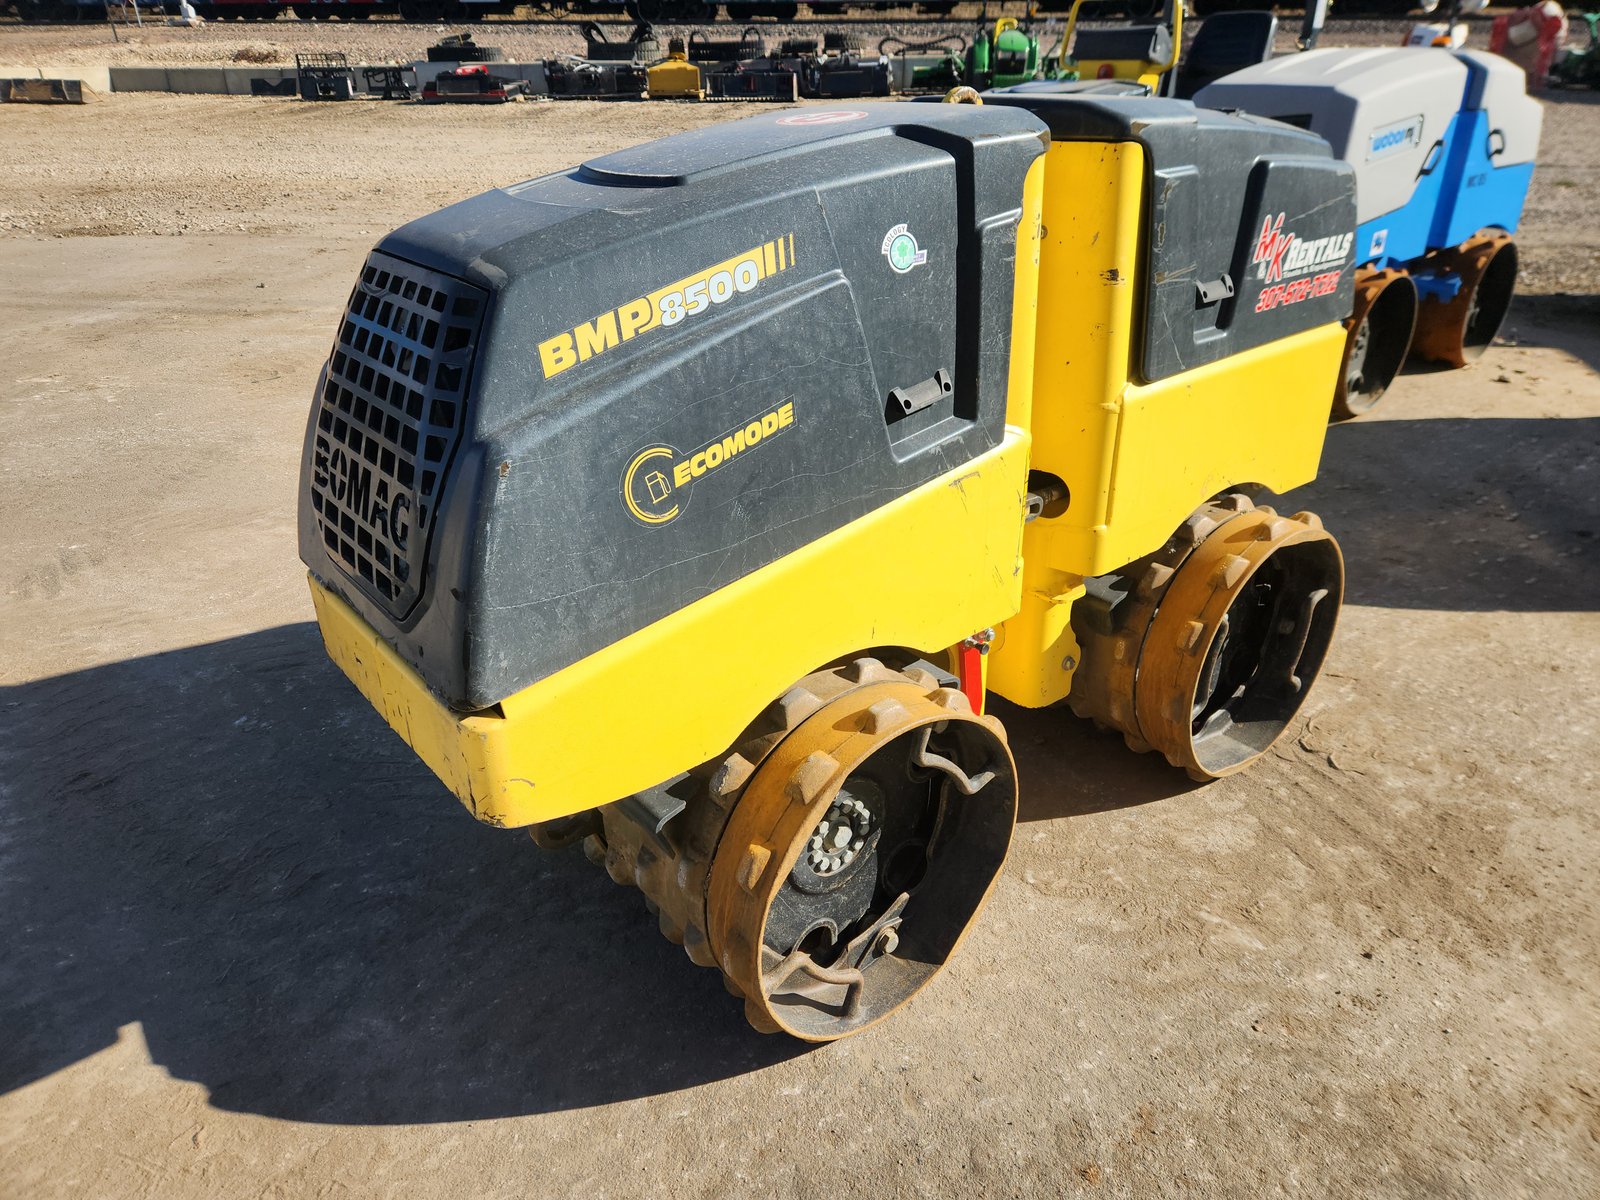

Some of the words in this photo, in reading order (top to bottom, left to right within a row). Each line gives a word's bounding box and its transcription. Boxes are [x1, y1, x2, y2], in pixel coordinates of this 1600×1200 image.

[883, 225, 906, 253] ECOLOGY
[538, 297, 653, 379] BMP
[658, 259, 759, 327] 8500
[314, 434, 411, 552] BOMAG
[673, 402, 793, 488] ECOMODE
